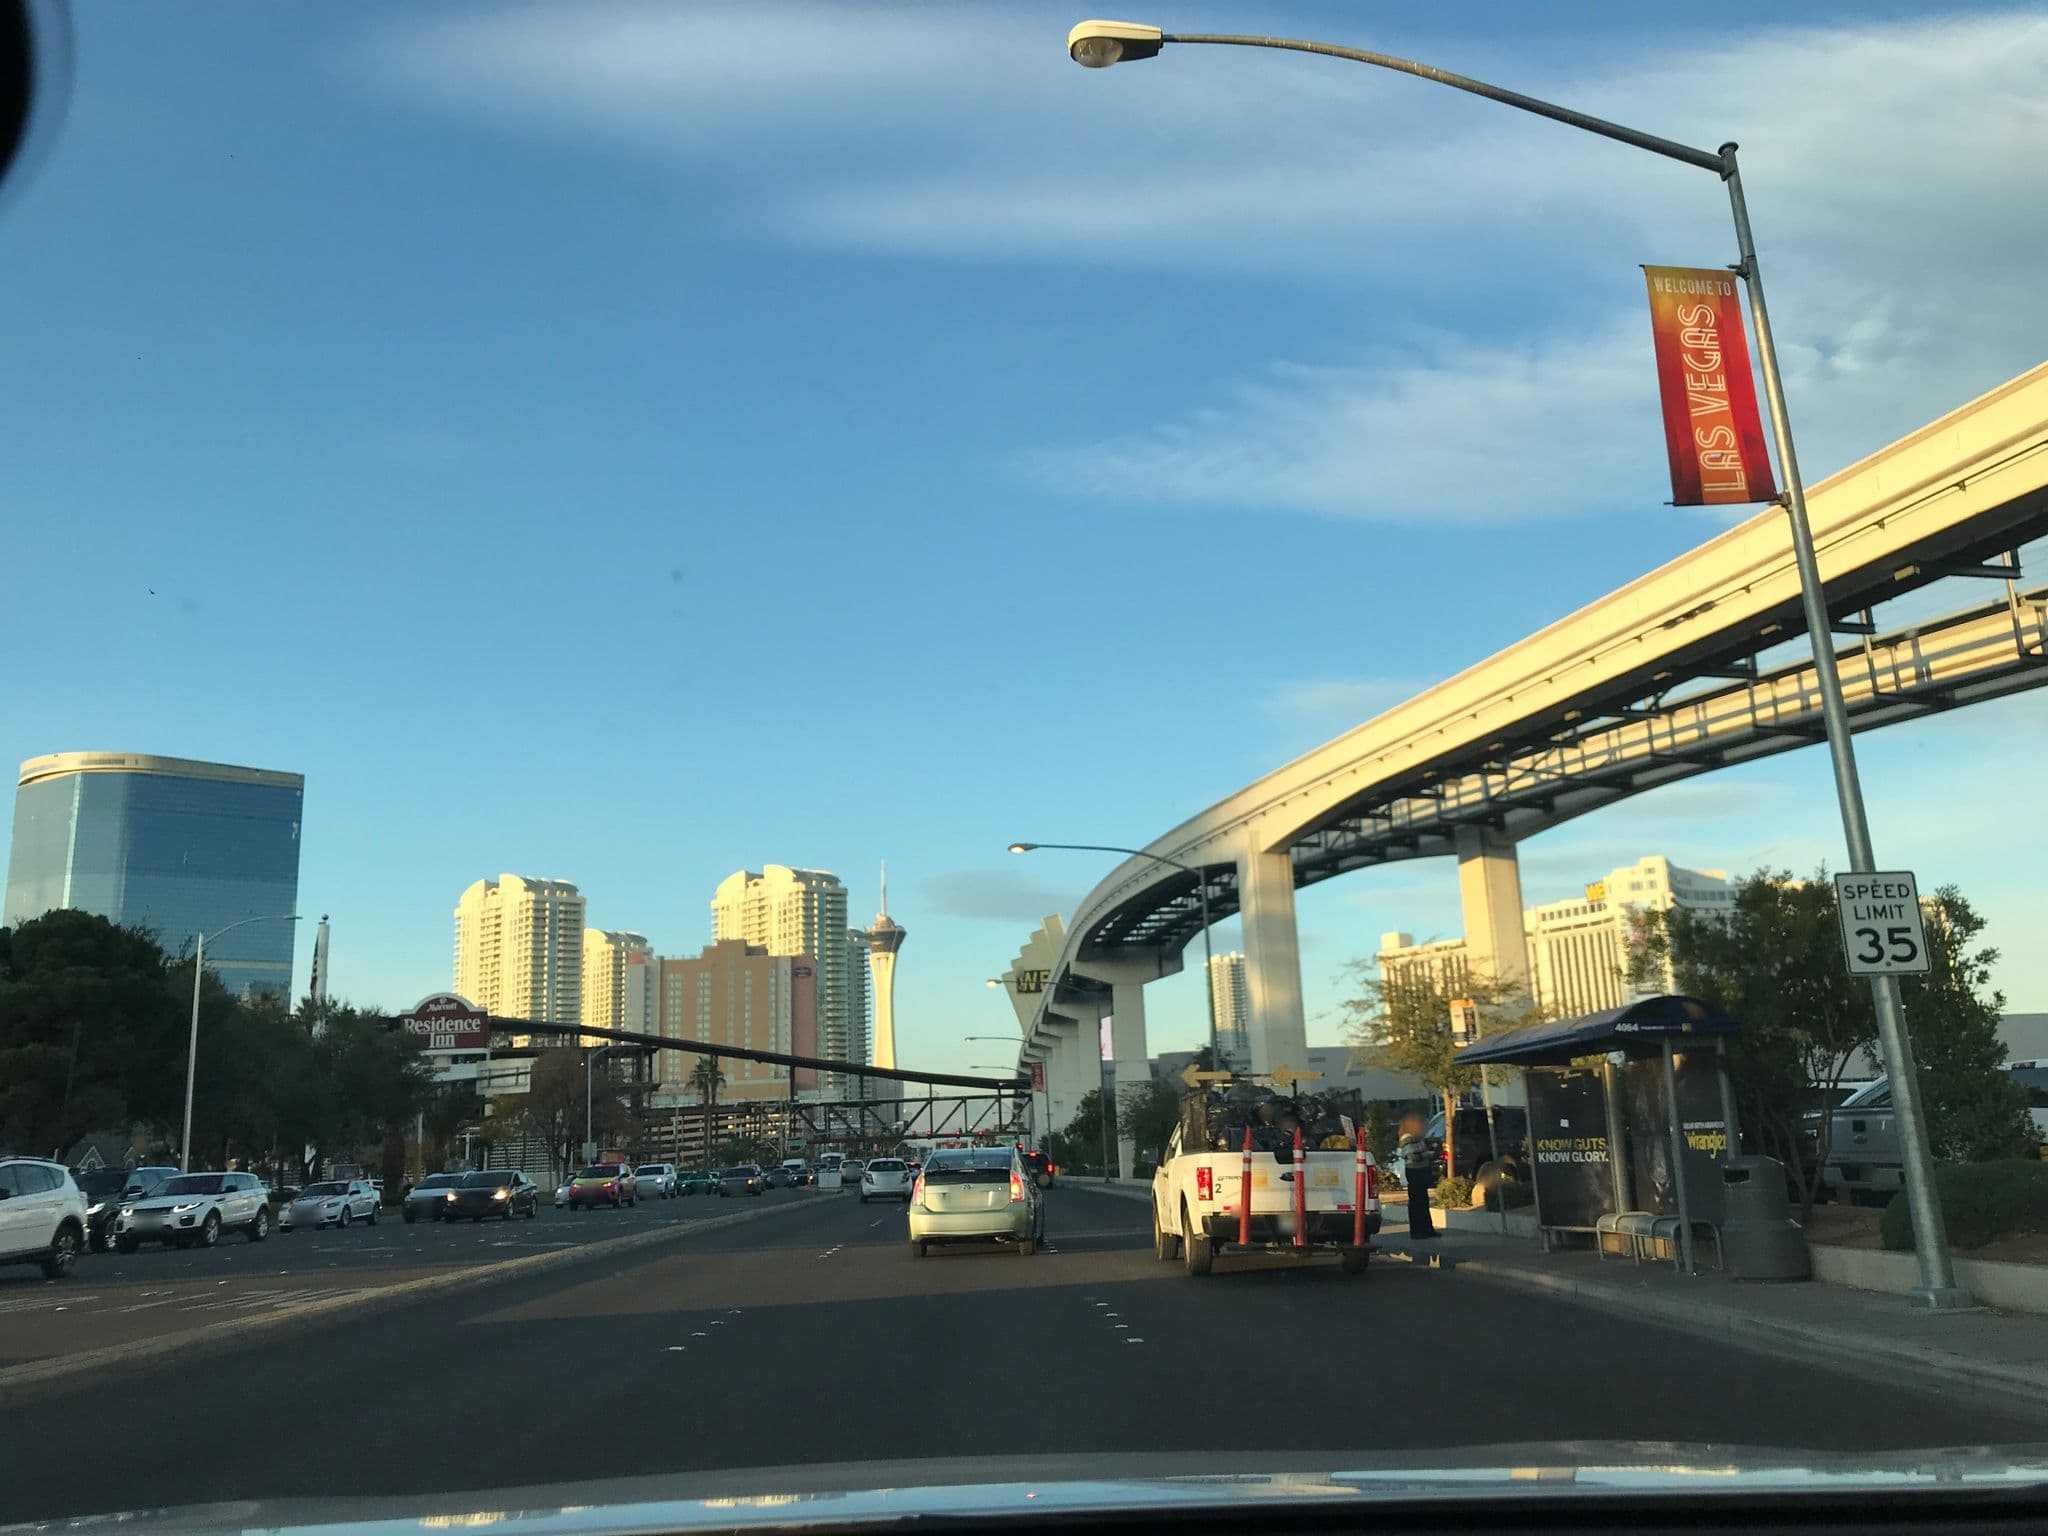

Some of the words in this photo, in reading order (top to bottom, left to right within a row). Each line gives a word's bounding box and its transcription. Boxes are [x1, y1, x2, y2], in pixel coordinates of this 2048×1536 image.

[1654, 276, 1714, 296] WELCOME
[1715, 281, 1732, 296] TO
[1677, 303, 1729, 417] VEGAS
[1695, 425, 1746, 491] LAS
[1843, 883, 1910, 899] SPEED
[1854, 904, 1904, 920] LIMIT
[1855, 927, 1918, 964] 35
[404, 1017, 480, 1032] Residence
[429, 1032, 456, 1048] Inn
[1537, 1139, 1572, 1151] KNOW
[1538, 1152, 1570, 1163] KNOW
[1572, 1151, 1609, 1162] GLORY.
[1215, 1183, 1222, 1194] 2
